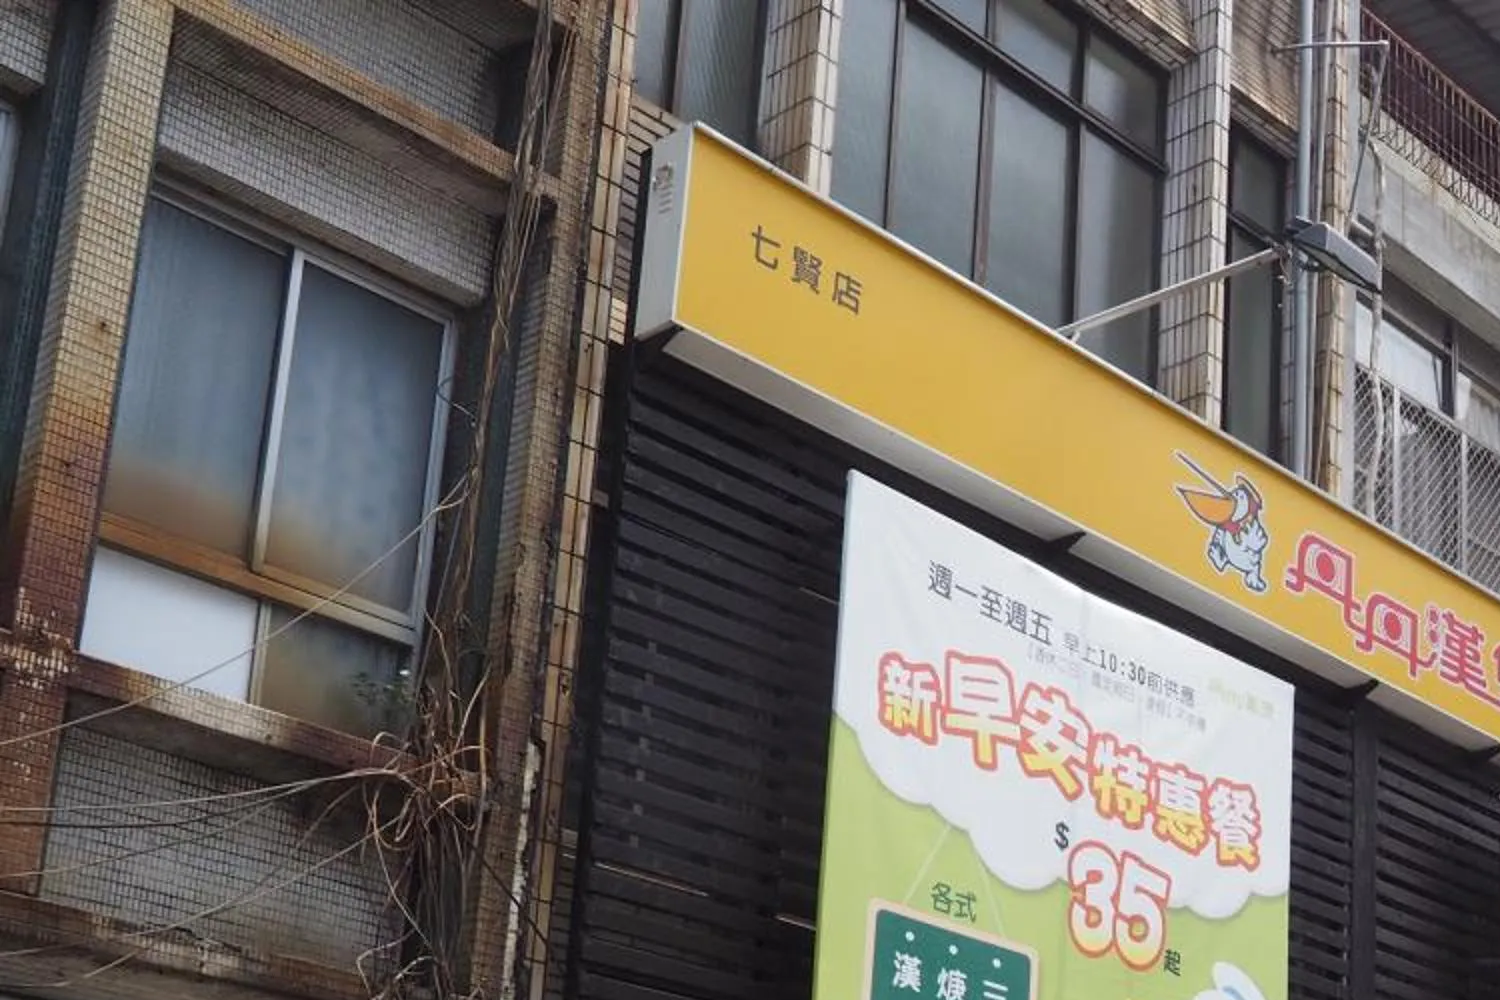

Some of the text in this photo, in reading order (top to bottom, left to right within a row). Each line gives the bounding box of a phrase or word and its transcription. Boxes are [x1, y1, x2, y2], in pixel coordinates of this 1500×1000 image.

[752, 224, 861, 315] 七賢店
[928, 559, 1053, 647] 週一至週五
[878, 649, 1262, 873] 新早安特惠餐
[931, 881, 977, 924] 各式
